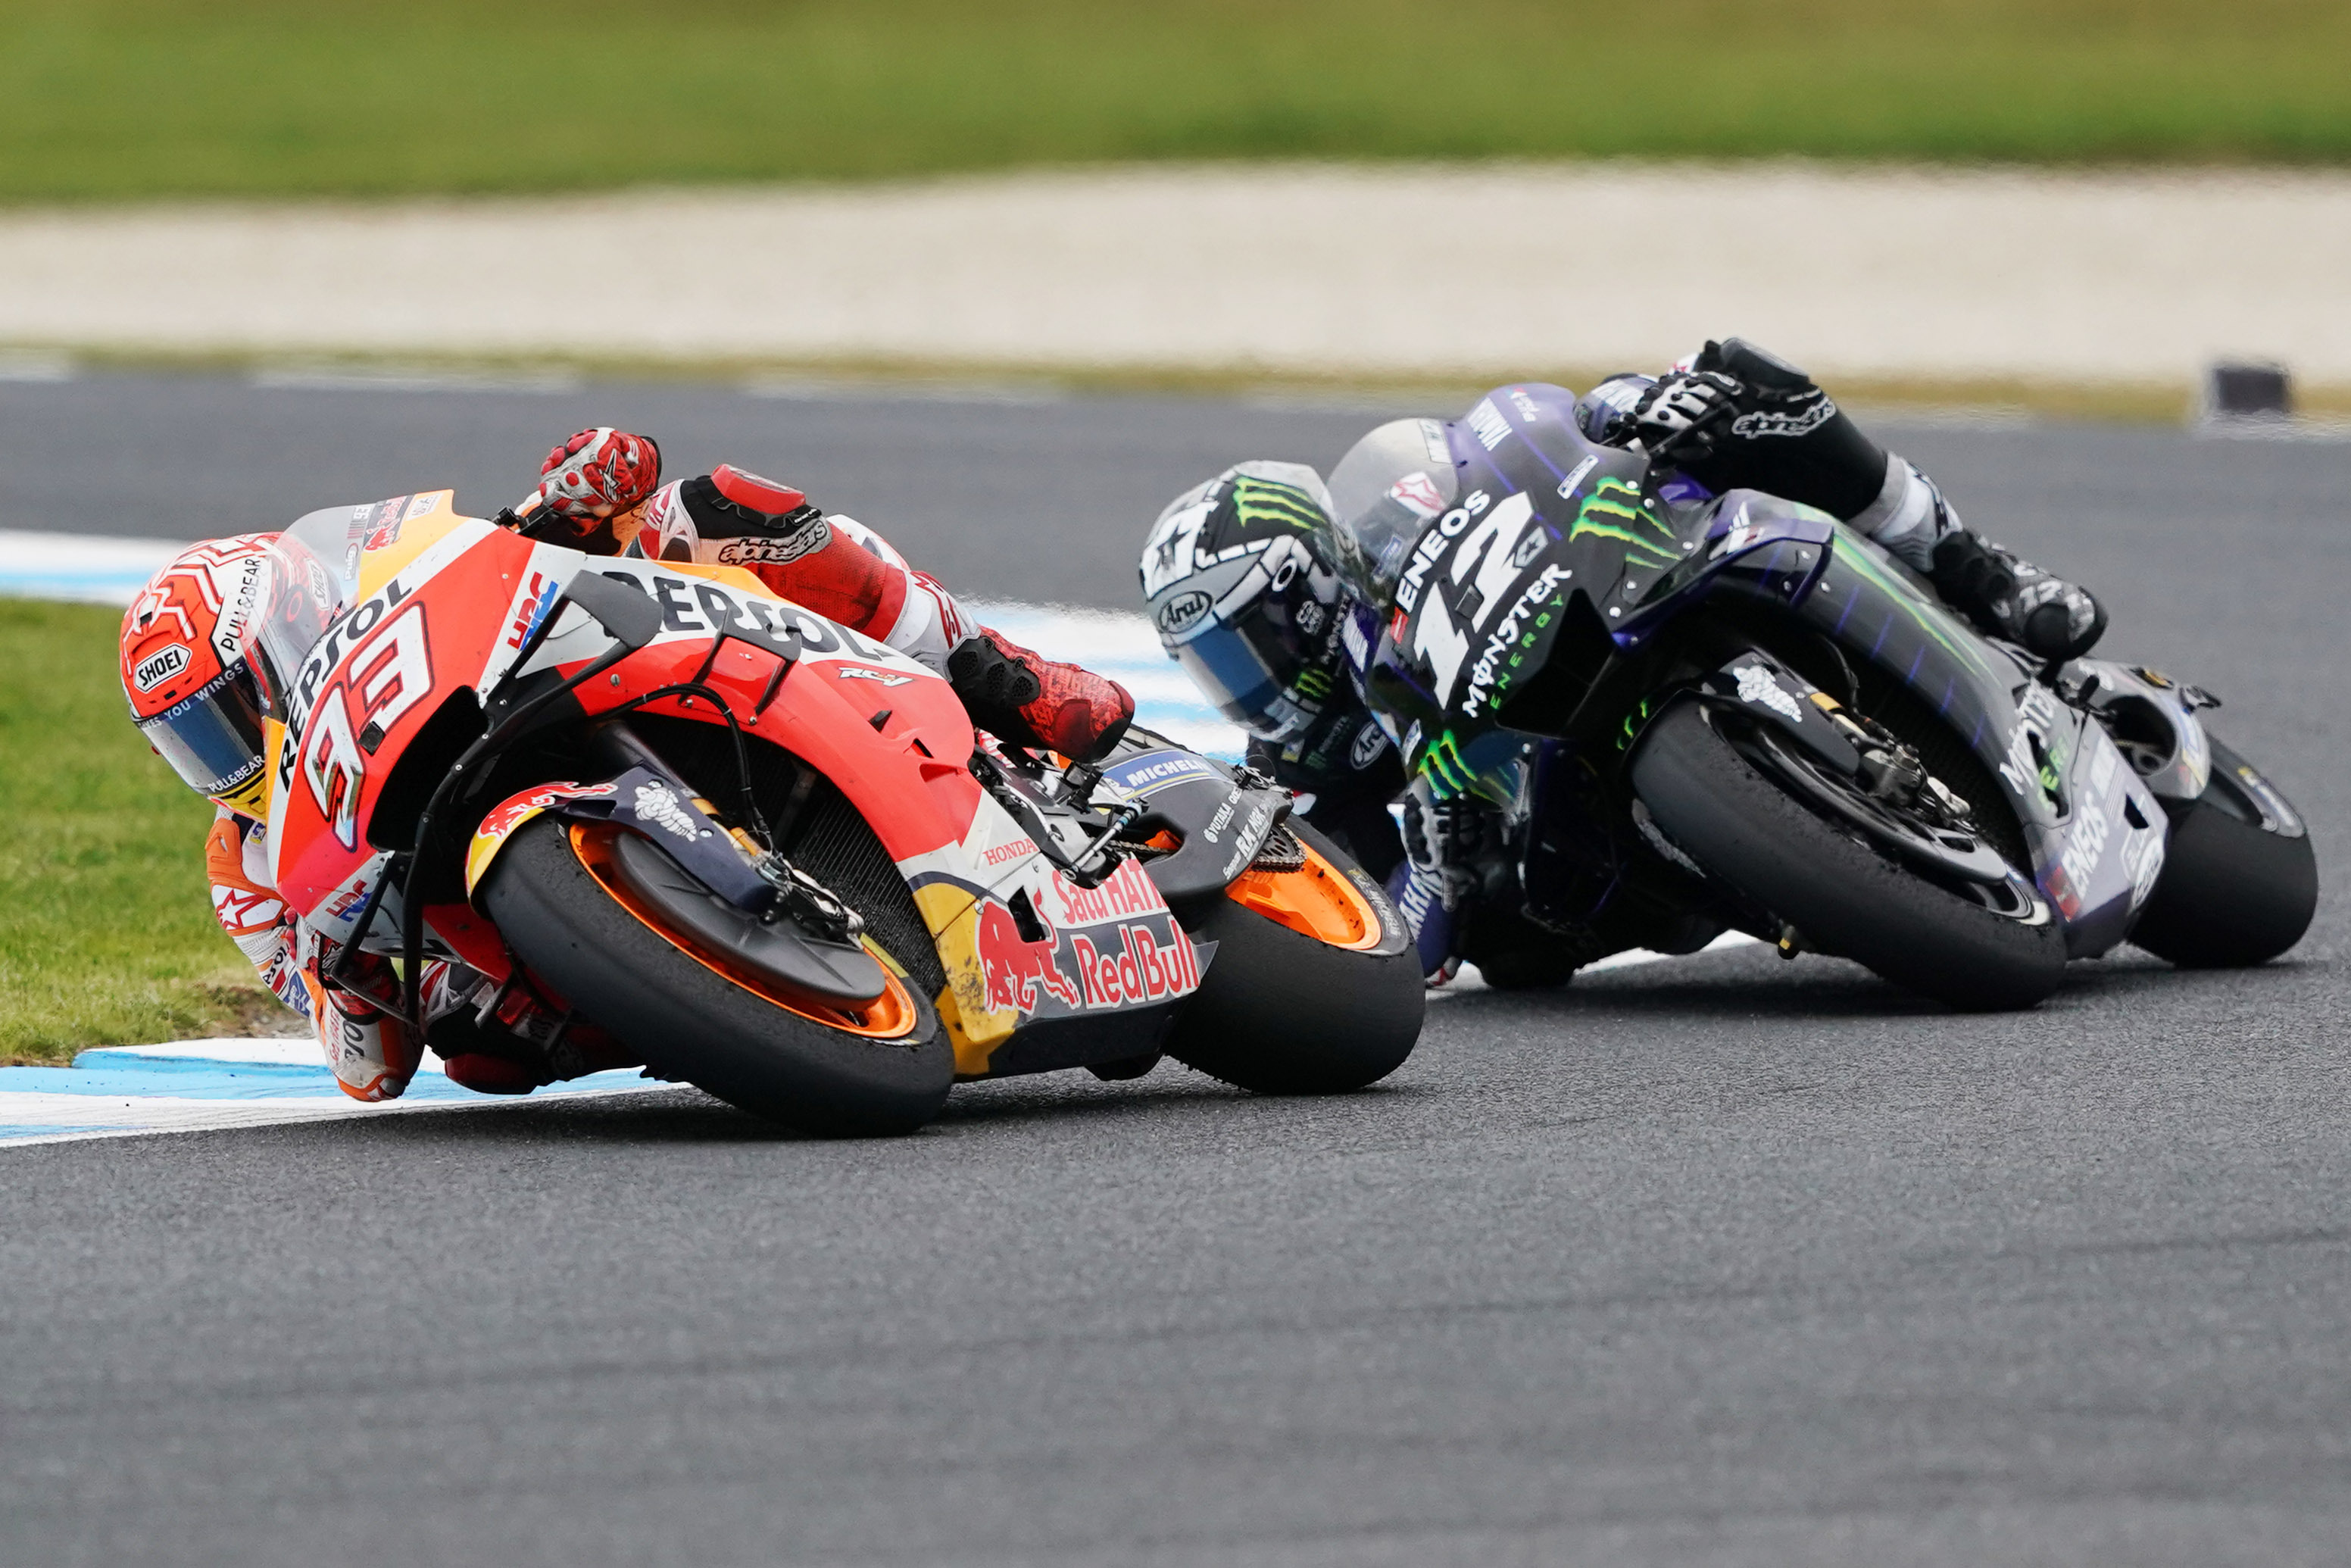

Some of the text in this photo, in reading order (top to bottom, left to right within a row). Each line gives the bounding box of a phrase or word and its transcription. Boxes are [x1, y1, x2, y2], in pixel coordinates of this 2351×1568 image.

[345, 550, 357, 581] Puig
[718, 520, 828, 566] alpinestars
[1395, 489, 1491, 613] ENEOS
[220, 558, 261, 652] PULL&BEAR
[1413, 490, 1535, 711] 12
[138, 649, 183, 687] SHOEI
[1490, 595, 1563, 710] ENERGY
[164, 700, 192, 720] YOU
[195, 662, 245, 701] WINGS
[279, 579, 413, 792] REPSOL
[304, 600, 435, 853] 93
[208, 754, 265, 793] PULL&BEAR
[1209, 802, 1232, 835] YUTAKA
[1247, 805, 1267, 833] NGK
[982, 838, 1038, 866] HONDA
[1051, 870, 1110, 925] Satu
[1072, 918, 1200, 1006] Red Bull
